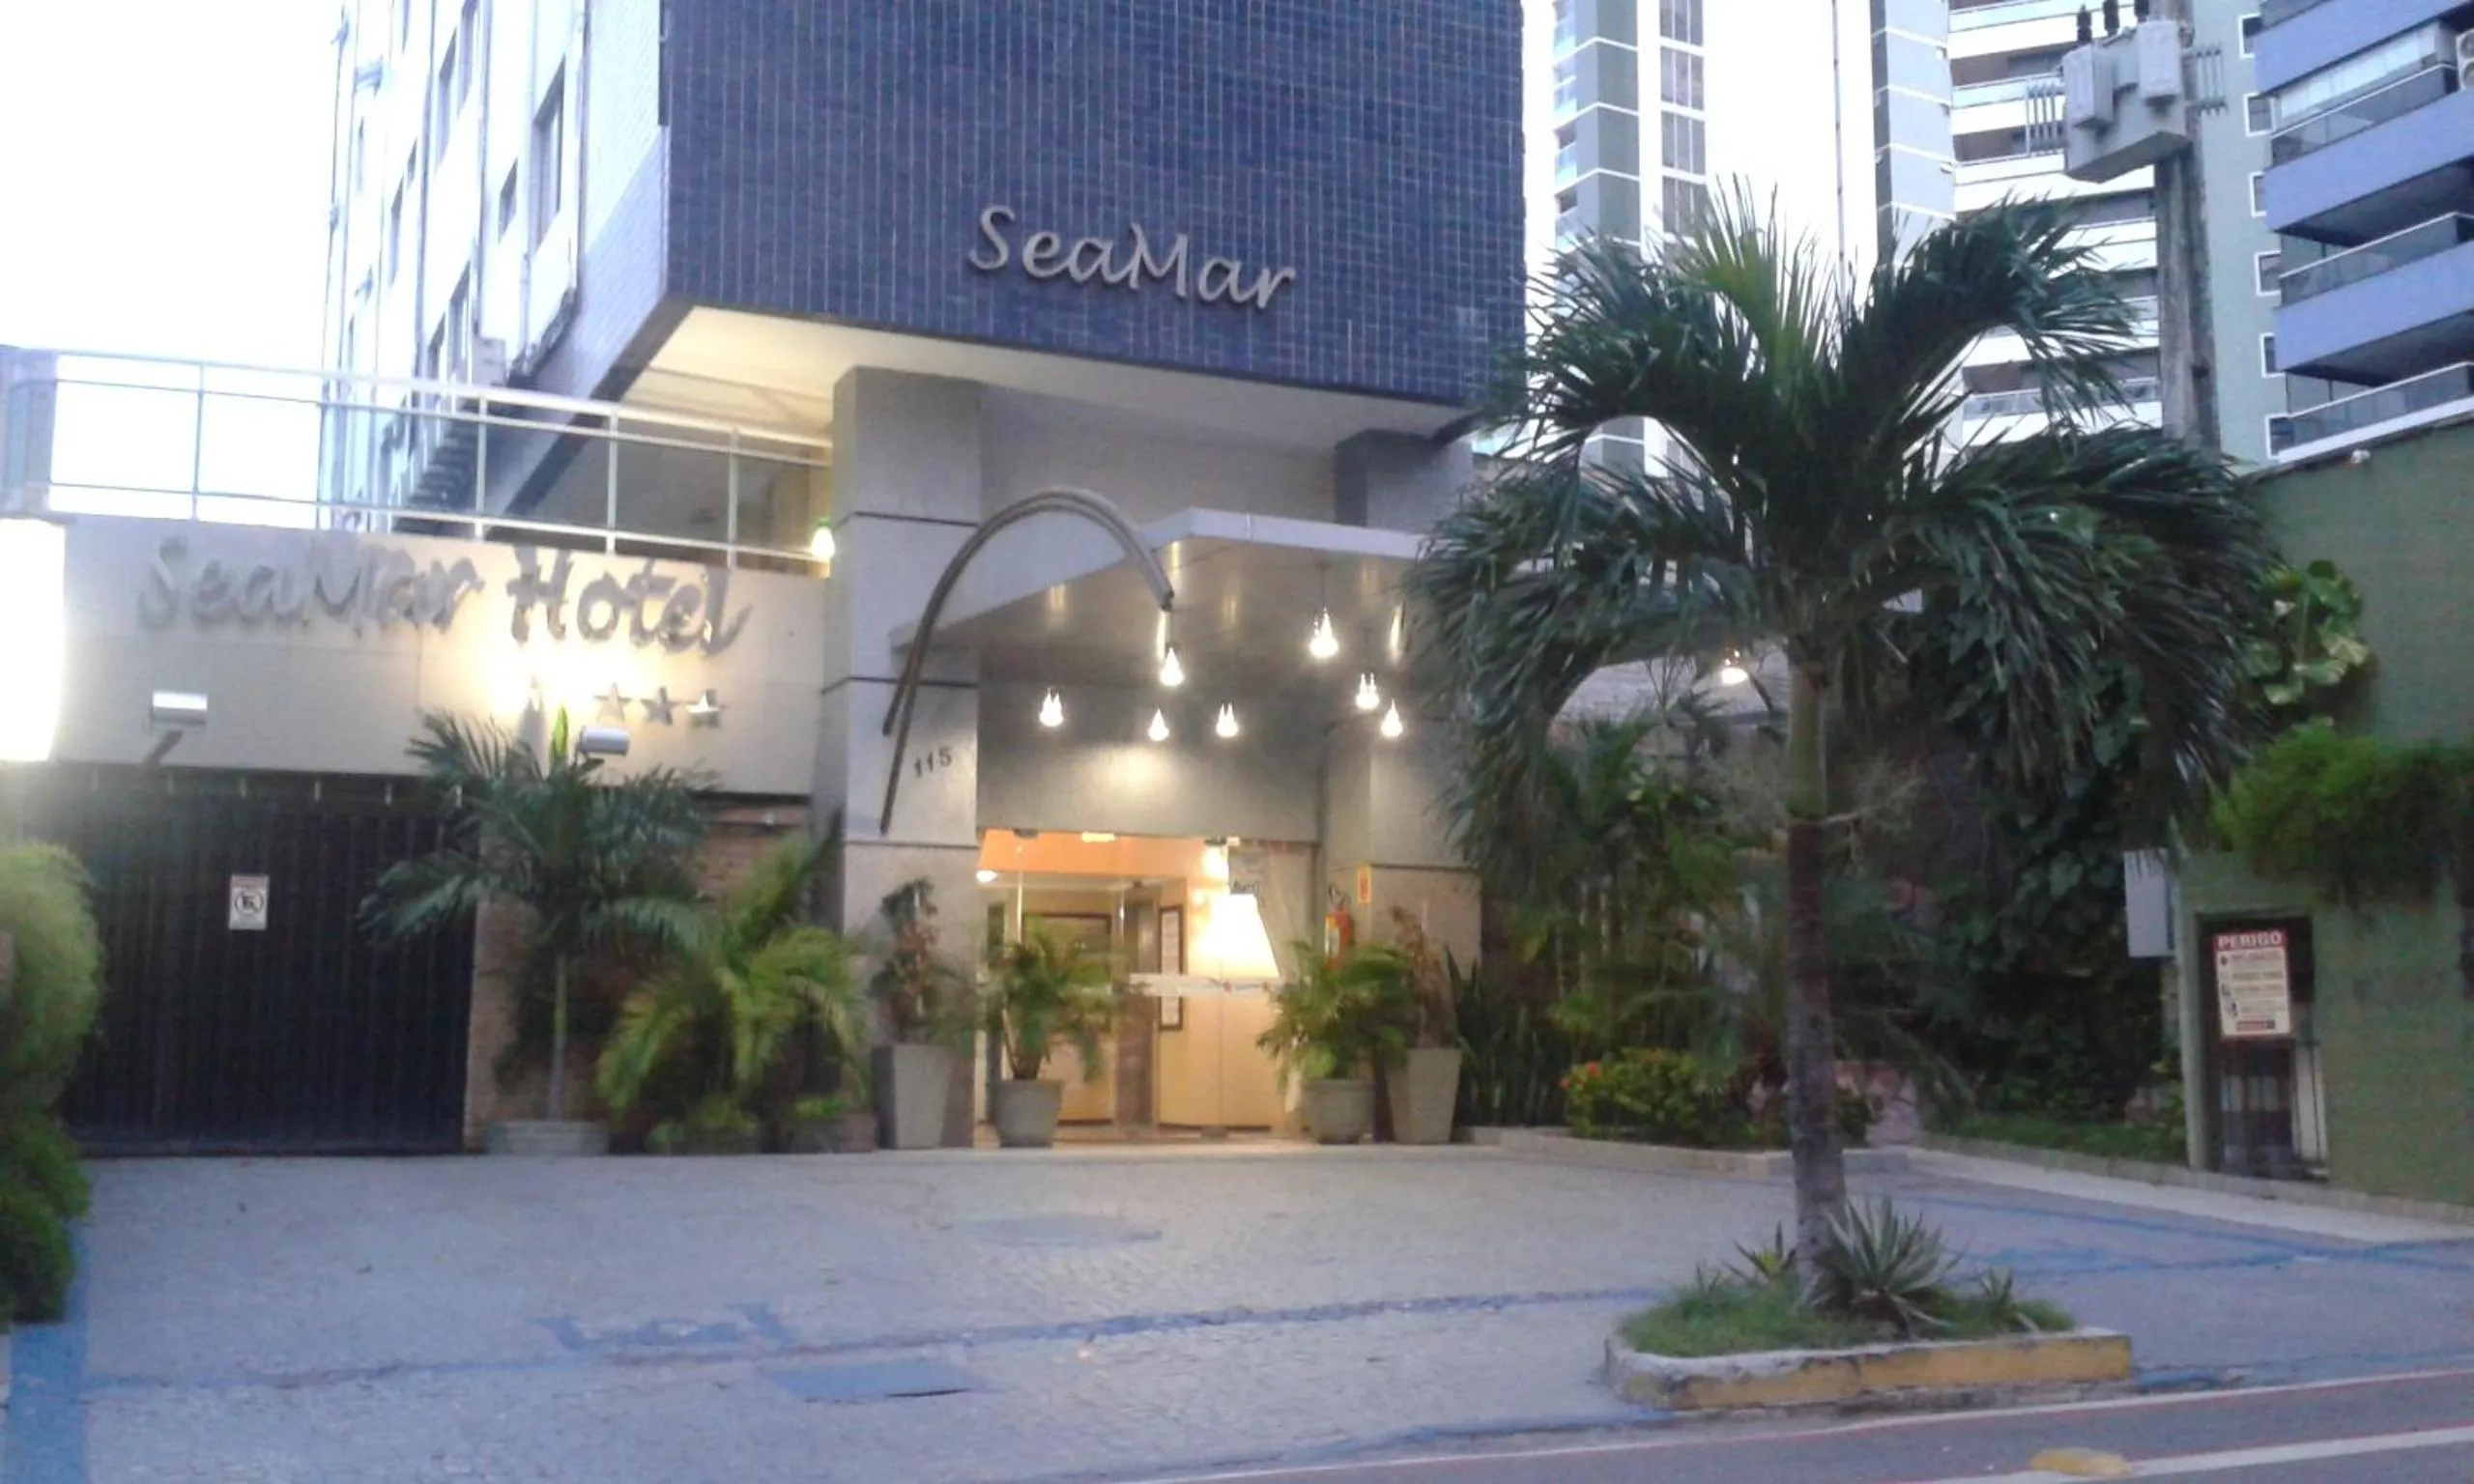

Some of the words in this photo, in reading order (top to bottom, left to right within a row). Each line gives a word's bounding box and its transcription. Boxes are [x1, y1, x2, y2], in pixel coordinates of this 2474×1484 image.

[968, 204, 1296, 309] SeaMar
[137, 531, 487, 638] SeaMar
[505, 545, 753, 658] Hotel
[913, 746, 953, 779] 115
